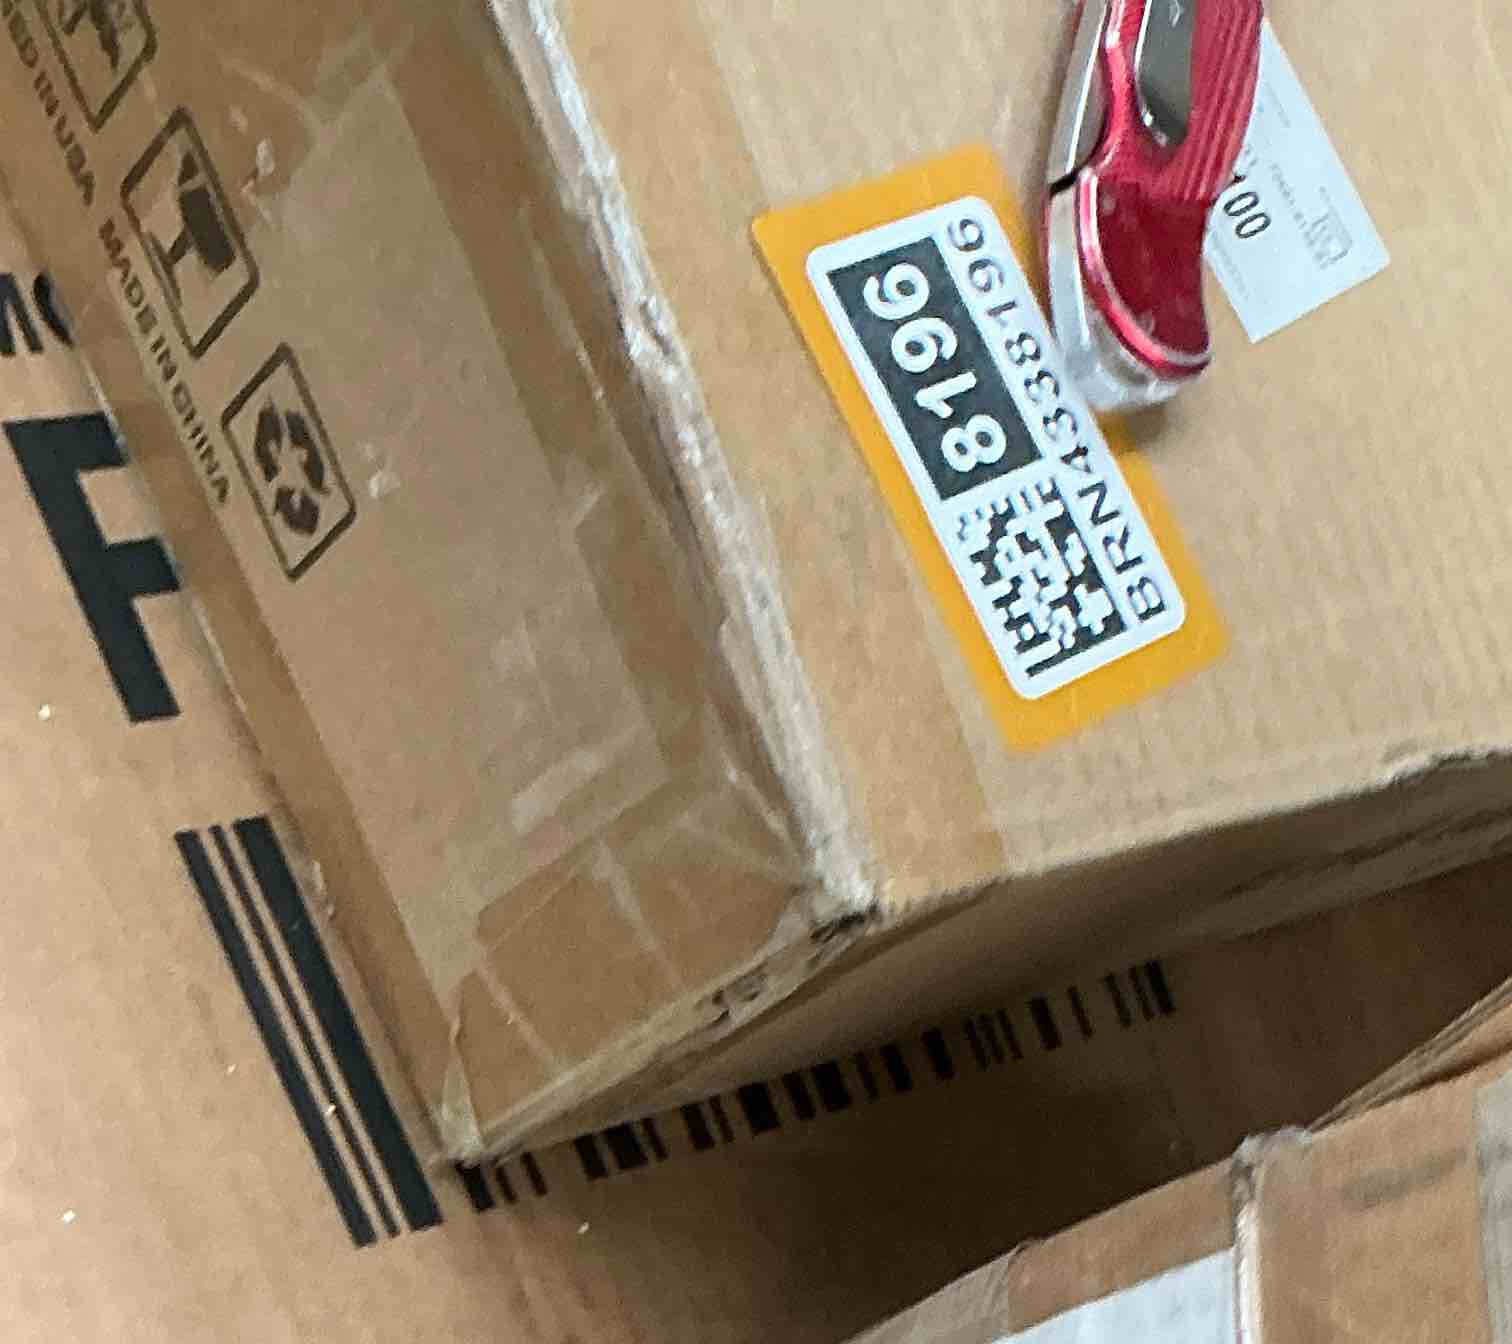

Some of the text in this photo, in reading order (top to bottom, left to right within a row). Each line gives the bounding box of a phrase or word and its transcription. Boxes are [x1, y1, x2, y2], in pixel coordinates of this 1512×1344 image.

[99, 217, 229, 504] MADE IN CHINA
[863, 260, 1007, 473] 8196
[947, 215, 1167, 625] BRN4338196
